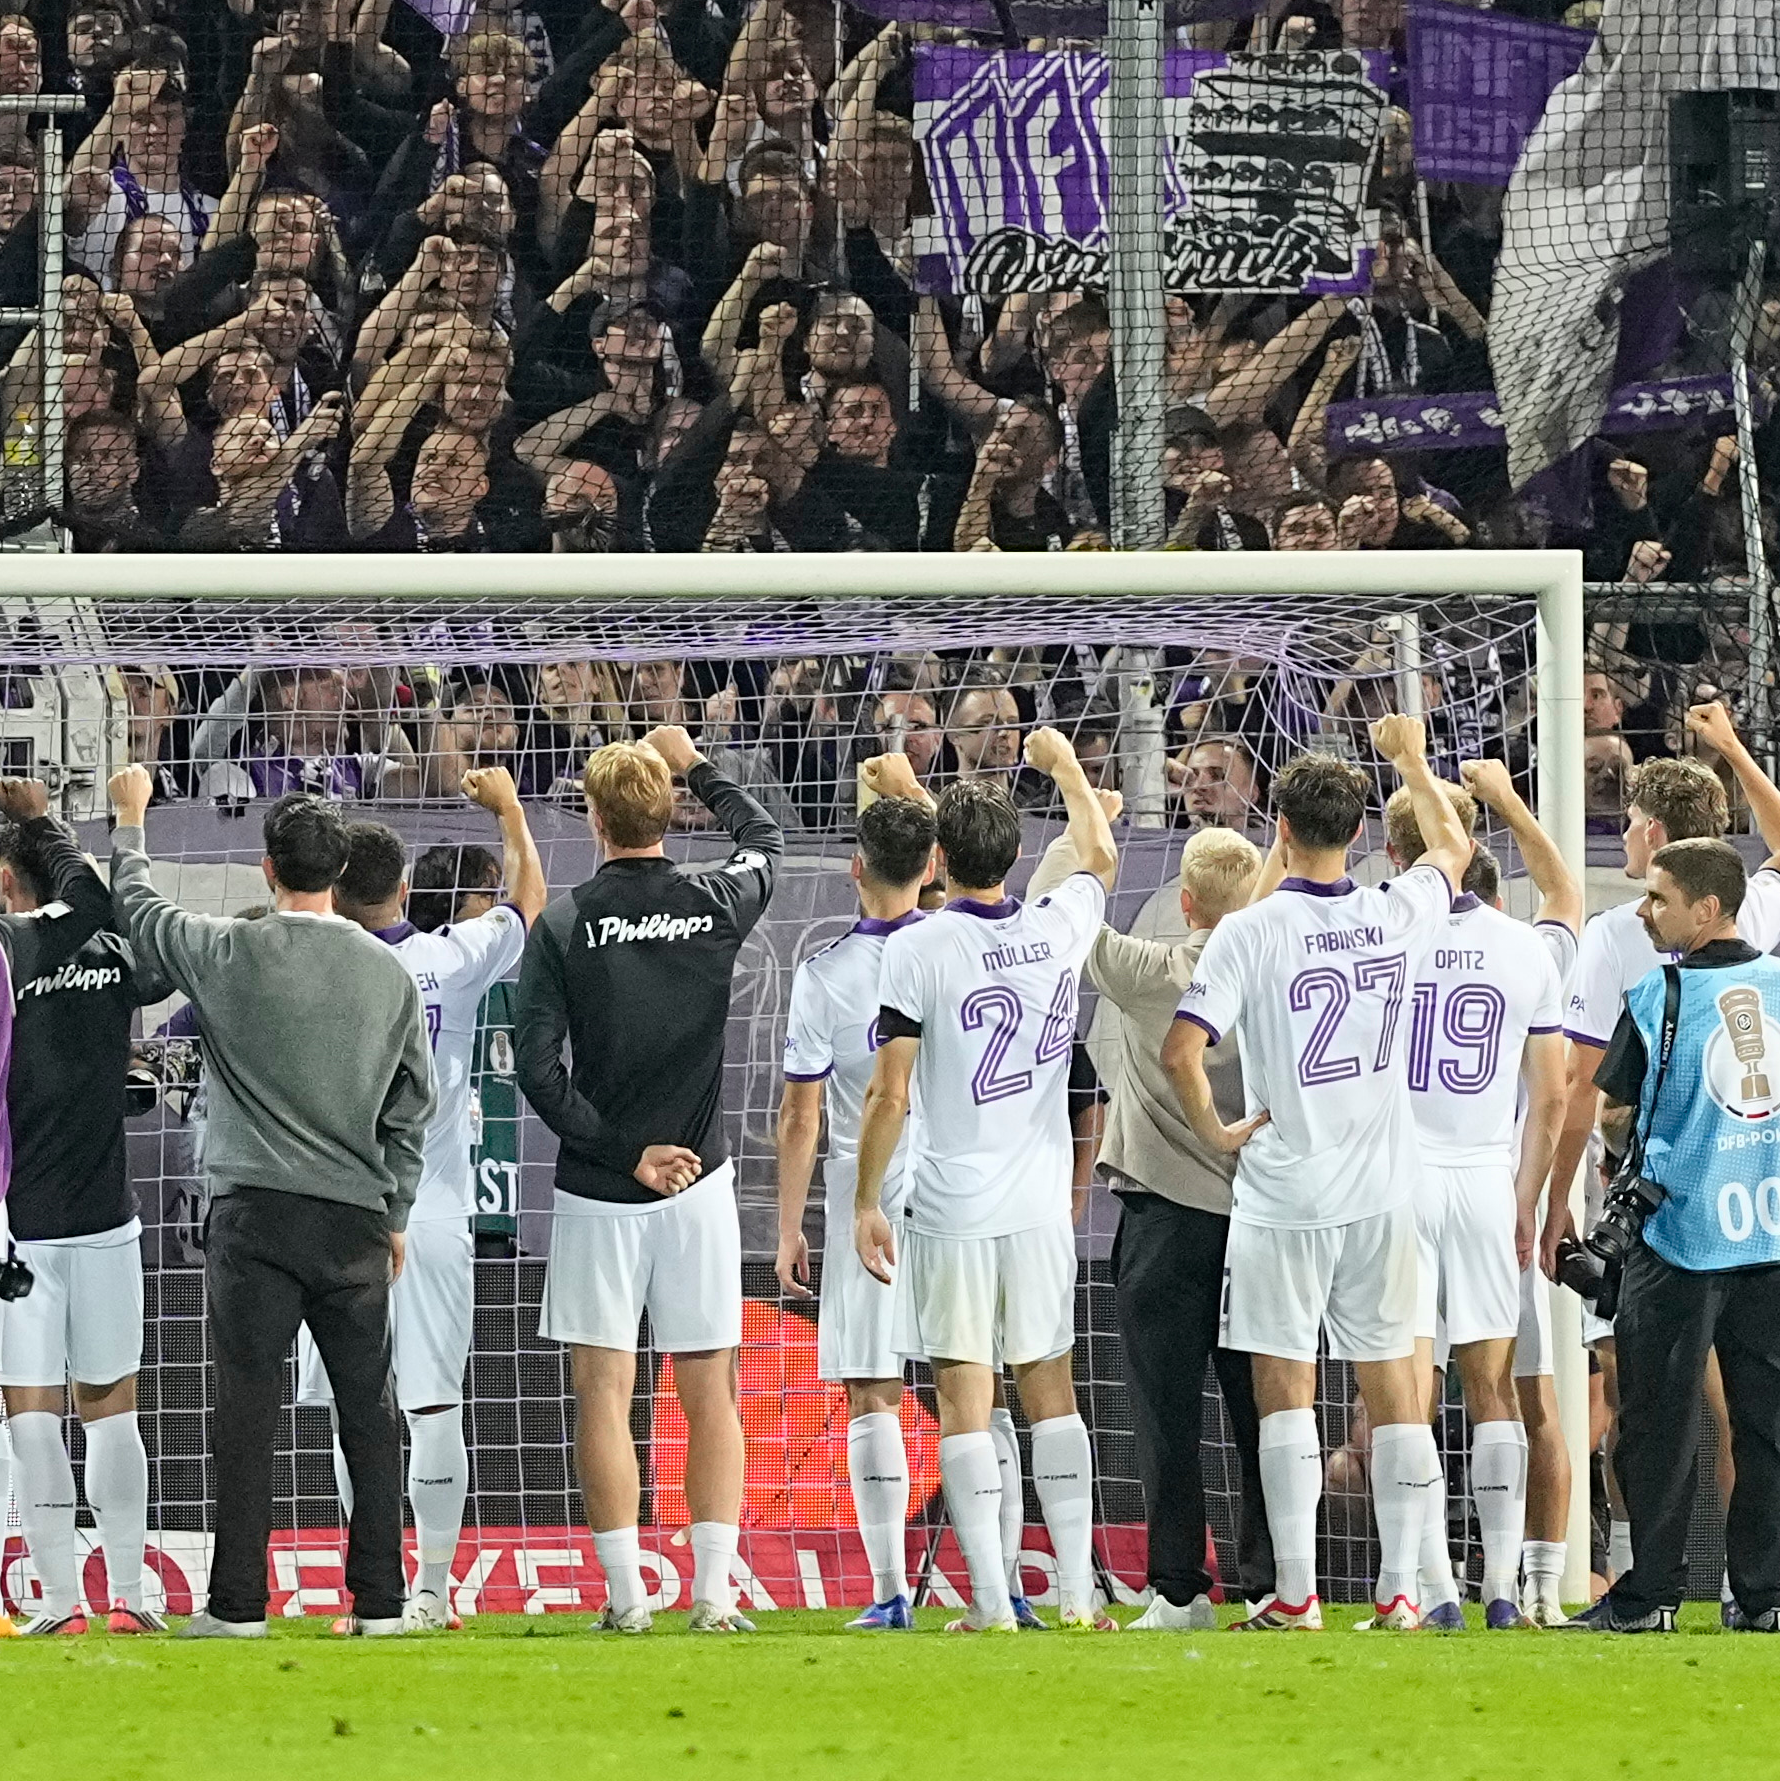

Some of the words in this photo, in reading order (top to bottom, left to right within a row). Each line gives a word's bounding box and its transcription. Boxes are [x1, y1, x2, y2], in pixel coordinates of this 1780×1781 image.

[597, 913, 714, 945] Philipps
[1303, 925, 1384, 955] FABINSKI
[1434, 948, 1485, 971] OPITZ
[960, 967, 1081, 1107] 24
[1289, 950, 1408, 1089] 27
[1408, 982, 1507, 1096] 19
[1661, 1020, 1676, 1063] SONY
